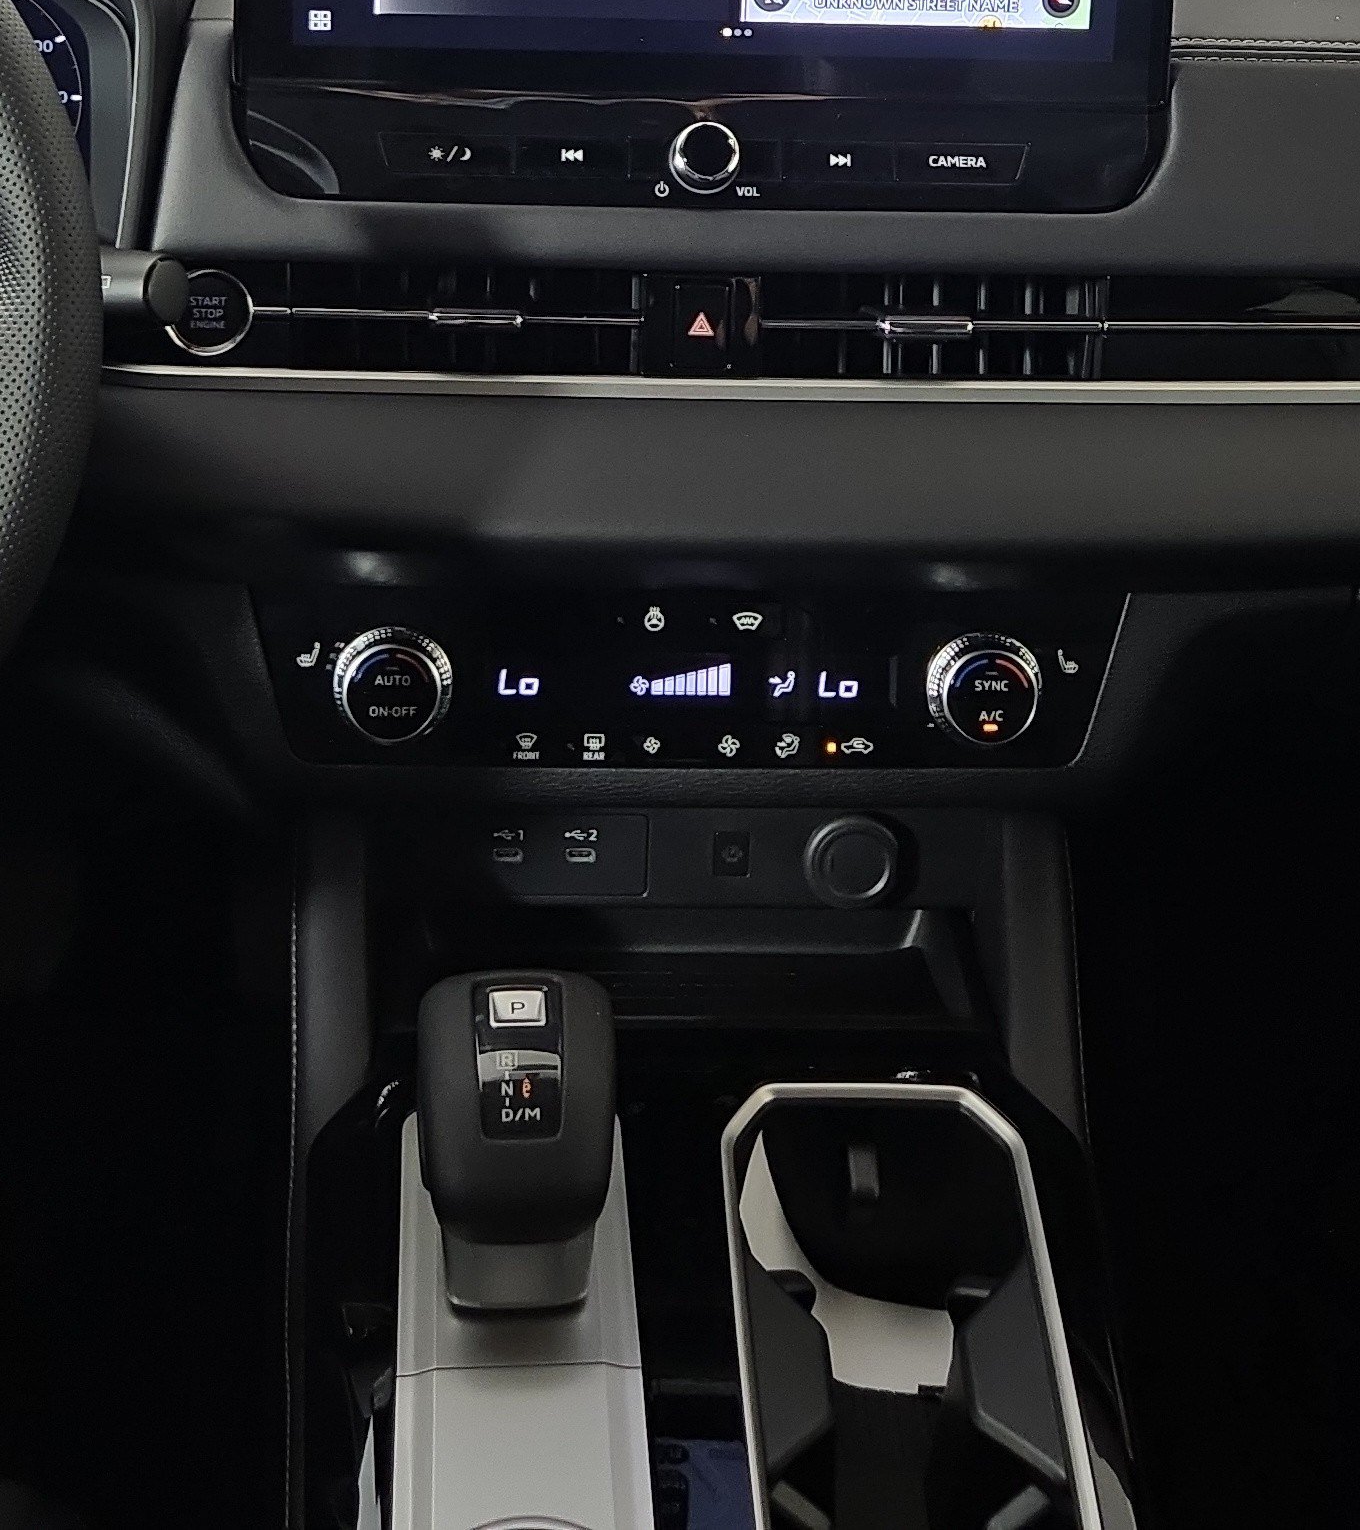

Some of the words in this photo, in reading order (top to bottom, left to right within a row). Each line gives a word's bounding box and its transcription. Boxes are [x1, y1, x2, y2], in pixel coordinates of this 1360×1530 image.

[929, 155, 987, 168] CAMERA
[736, 185, 761, 198] VOL
[190, 296, 228, 307] START
[193, 308, 224, 319] STOP
[190, 321, 226, 329] ENGINE
[374, 674, 411, 686] AUTO
[497, 668, 540, 696] Lo
[817, 670, 859, 698] Lo
[974, 679, 1010, 692] SYNC
[978, 710, 1004, 722] A/C
[513, 751, 540, 760] FRONT
[583, 751, 605, 761] REAR
[588, 829, 598, 841] 2
[510, 1000, 526, 1015] P
[500, 1053, 514, 1067] R
[500, 1081, 513, 1097] N
[501, 1107, 541, 1122] D/M
